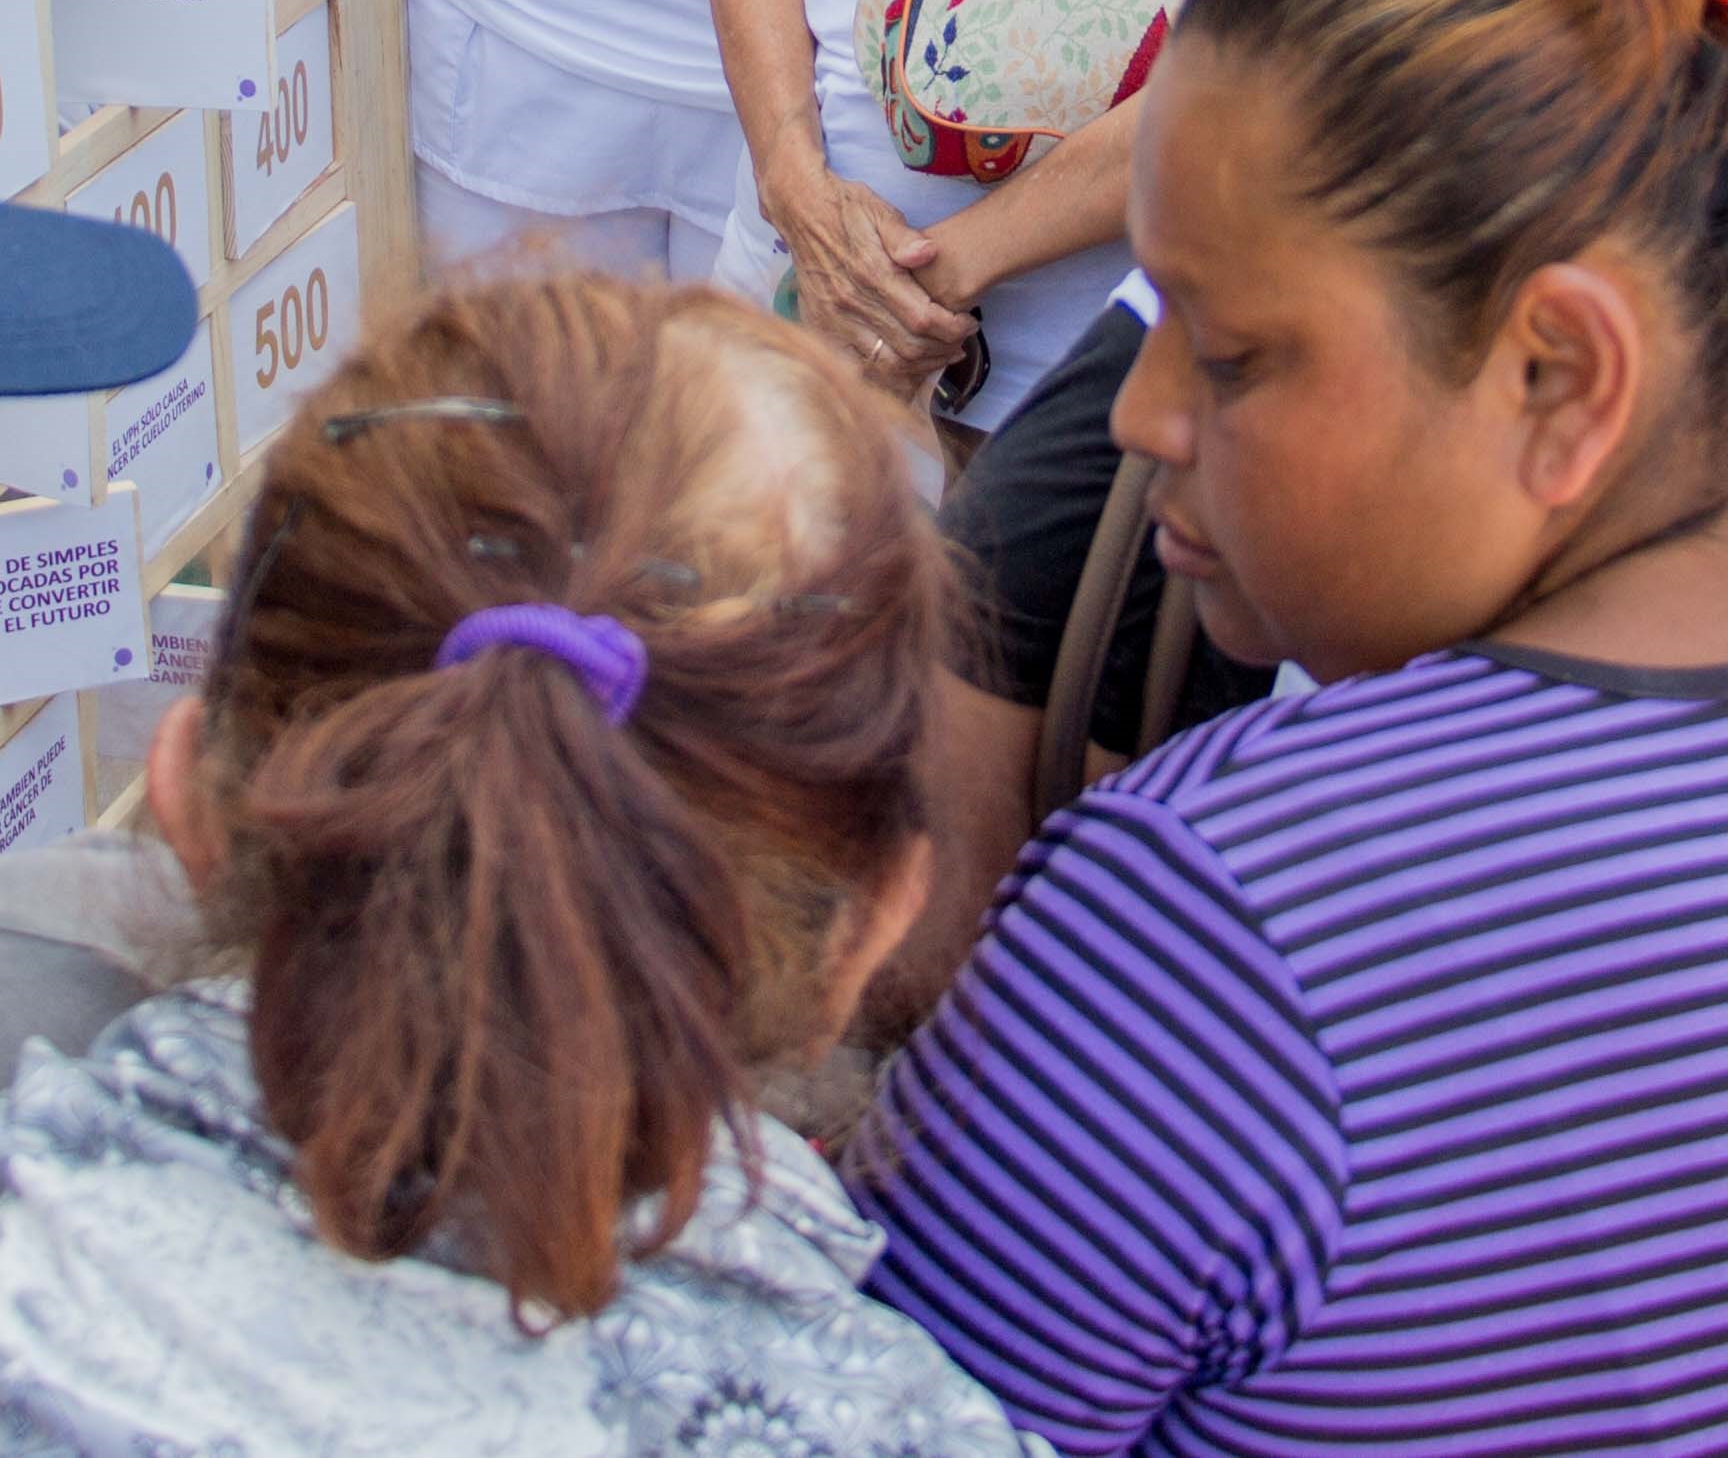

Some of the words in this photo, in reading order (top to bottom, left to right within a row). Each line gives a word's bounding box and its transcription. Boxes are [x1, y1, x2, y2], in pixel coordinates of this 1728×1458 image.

[254, 267, 329, 390] 500
[112, 438, 123, 457] EL
[122, 420, 141, 446] VPH
[140, 402, 162, 431] SÓLO
[162, 377, 189, 410] CAUSA
[129, 440, 141, 461] DE
[141, 413, 172, 450] CUELLO
[171, 381, 207, 422] UTERINO
[5, 555, 32, 574] DE
[36, 539, 119, 568] SIMPLES
[78, 559, 120, 580] POR
[8, 577, 121, 613] CONVERTIR
[4, 616, 26, 634] EL
[30, 598, 111, 630] FUTURO
[36, 735, 67, 775] PUEDE
[3, 784, 39, 828] CÁNCER
[40, 769, 53, 791] DE
